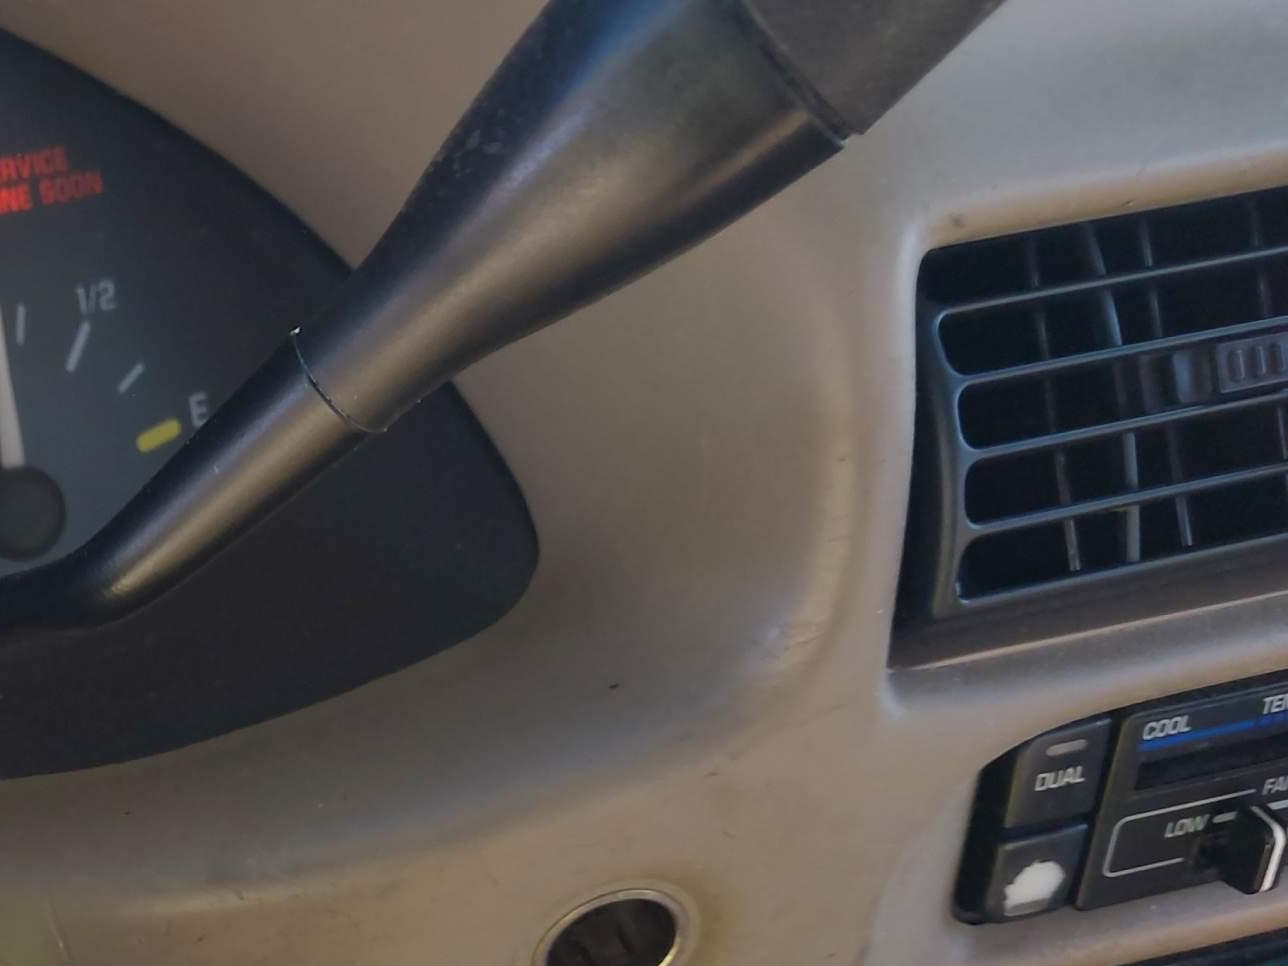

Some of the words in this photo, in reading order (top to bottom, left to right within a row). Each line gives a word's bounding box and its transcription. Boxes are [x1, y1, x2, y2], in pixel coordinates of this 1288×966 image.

[39, 170, 102, 205] SOON
[188, 392, 210, 427] E
[1142, 715, 1192, 741] COOL
[1034, 764, 1086, 792] DUAL
[1164, 813, 1212, 838] LOW
